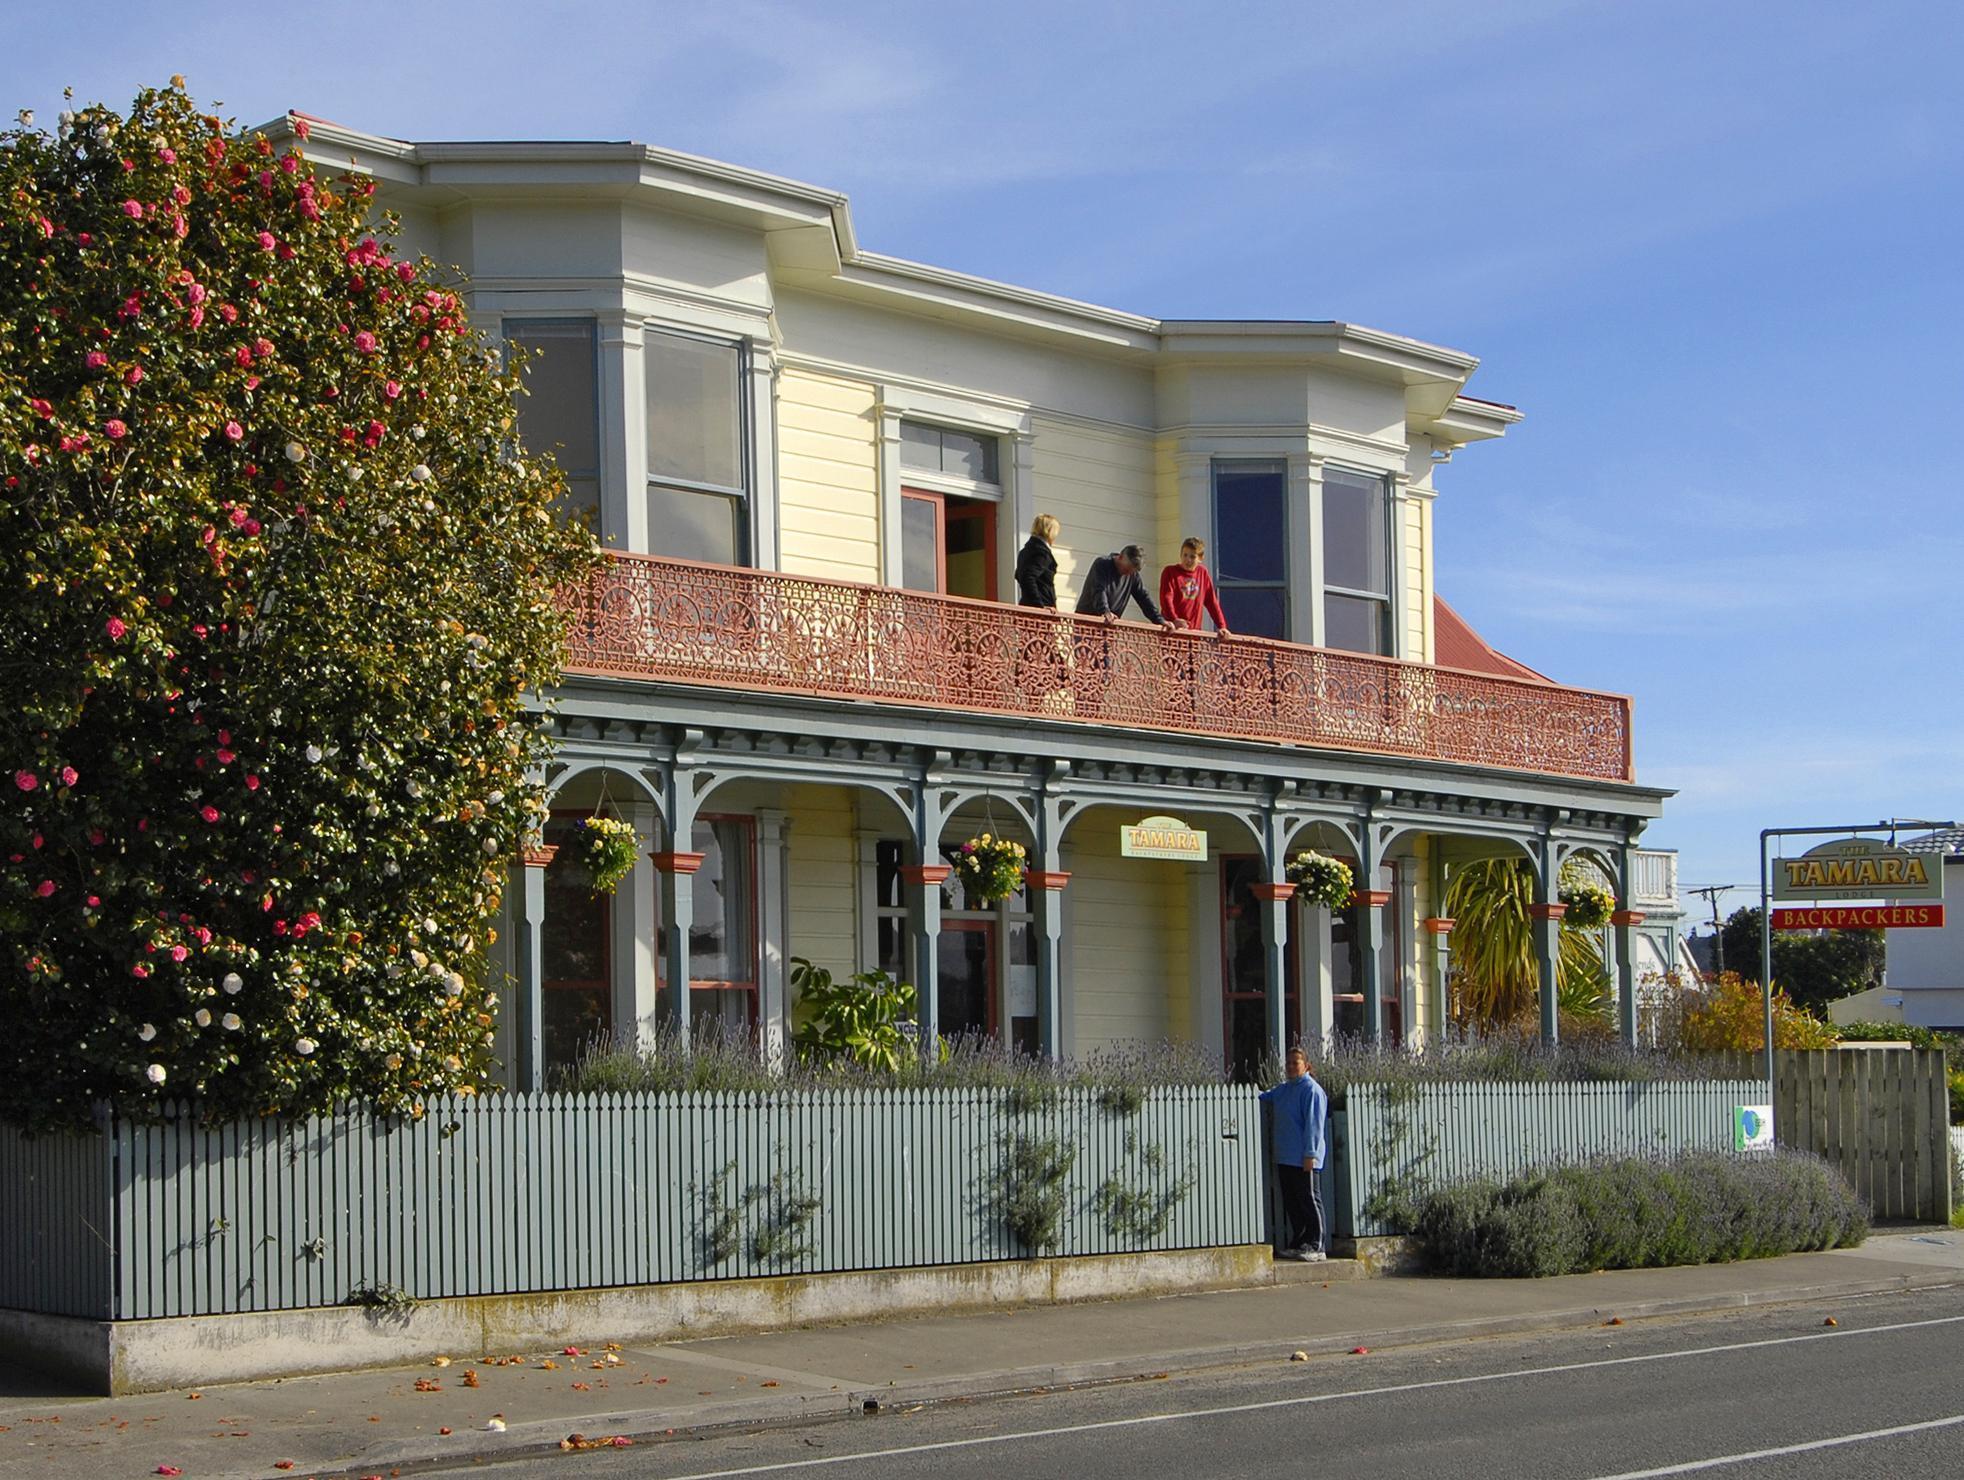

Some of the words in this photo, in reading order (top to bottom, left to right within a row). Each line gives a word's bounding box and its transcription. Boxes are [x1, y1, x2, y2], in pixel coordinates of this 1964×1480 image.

[1128, 829, 1200, 850] TAMARA
[1785, 858, 1928, 887] TAMARA
[1784, 908, 1929, 926] BACKPACKERS
